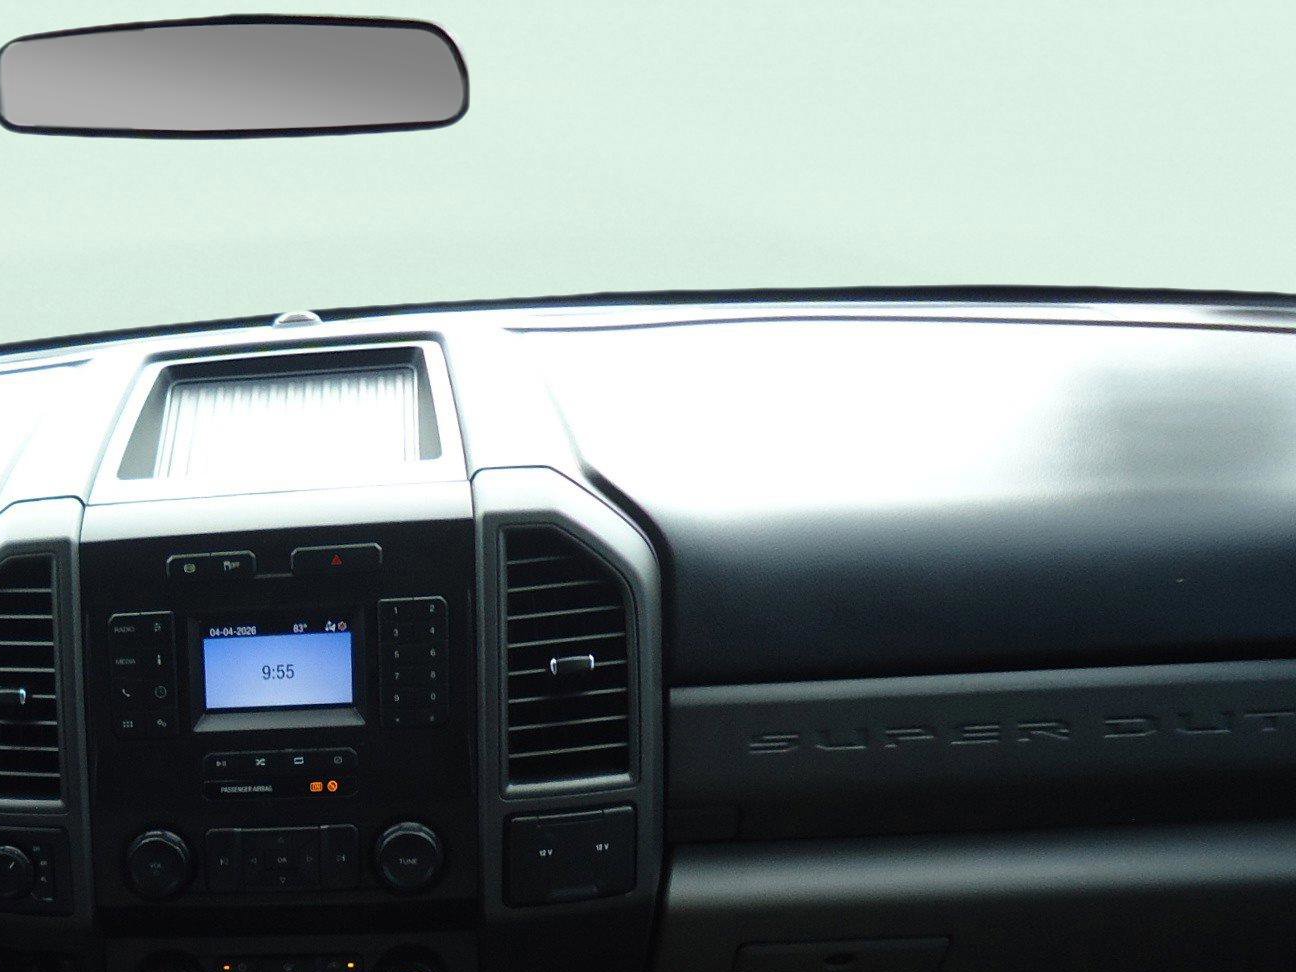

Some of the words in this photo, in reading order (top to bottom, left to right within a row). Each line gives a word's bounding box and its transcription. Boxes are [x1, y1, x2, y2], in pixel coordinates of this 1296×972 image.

[209, 624, 257, 637] 04-04-2026
[261, 664, 296, 680] 9:55
[749, 716, 1071, 754] SUPER
[220, 786, 252, 794] PASSENGER
[252, 784, 274, 793] AIRBAG
